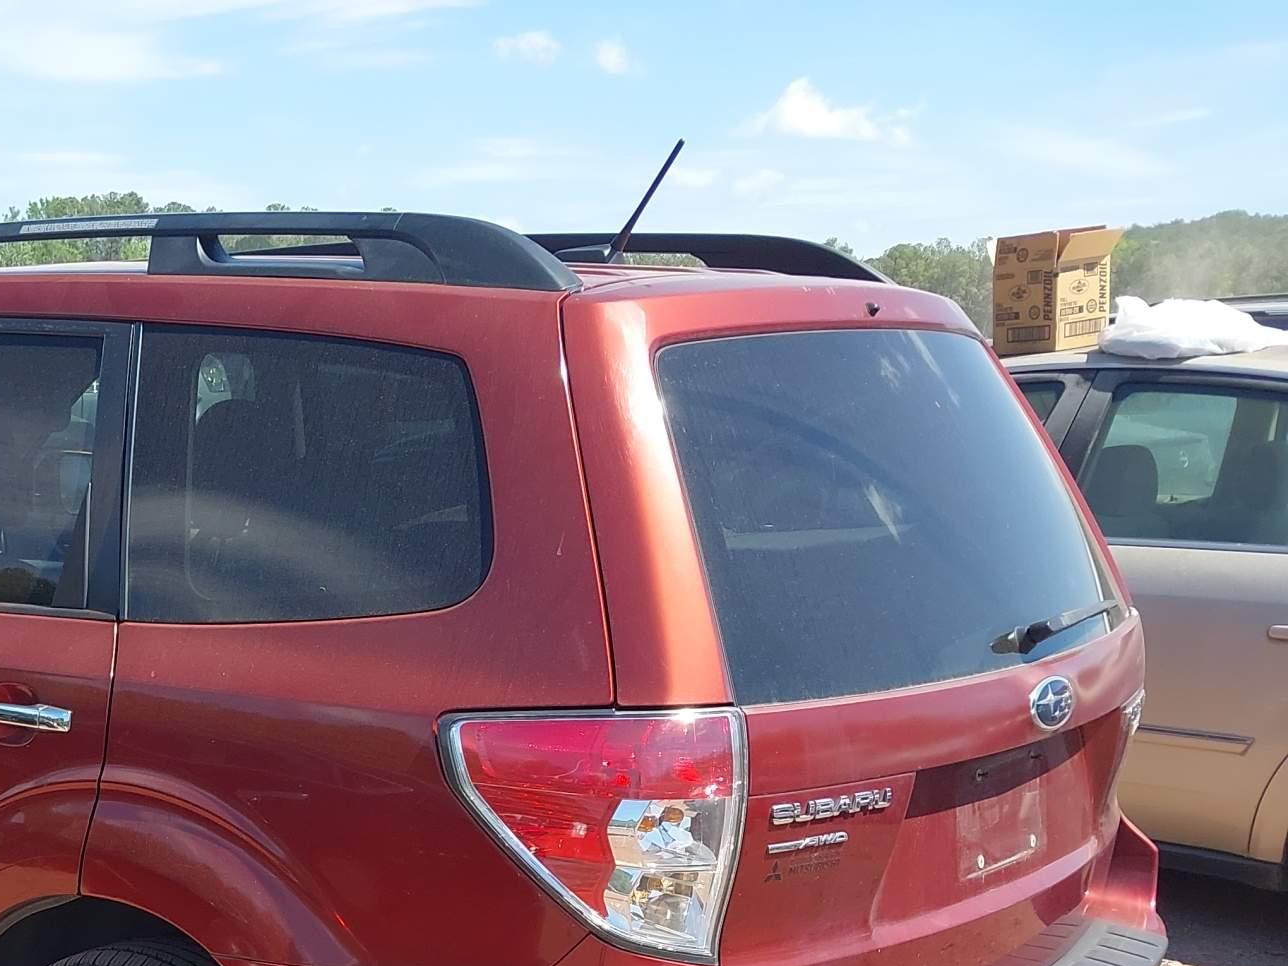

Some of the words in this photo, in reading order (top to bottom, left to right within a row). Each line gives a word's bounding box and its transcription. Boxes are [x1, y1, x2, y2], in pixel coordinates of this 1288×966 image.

[1043, 269, 1053, 321] PENNZOIL
[1099, 262, 1107, 312] PENNZOIL
[772, 788, 893, 826] SUBARU
[800, 832, 849, 849] AWD
